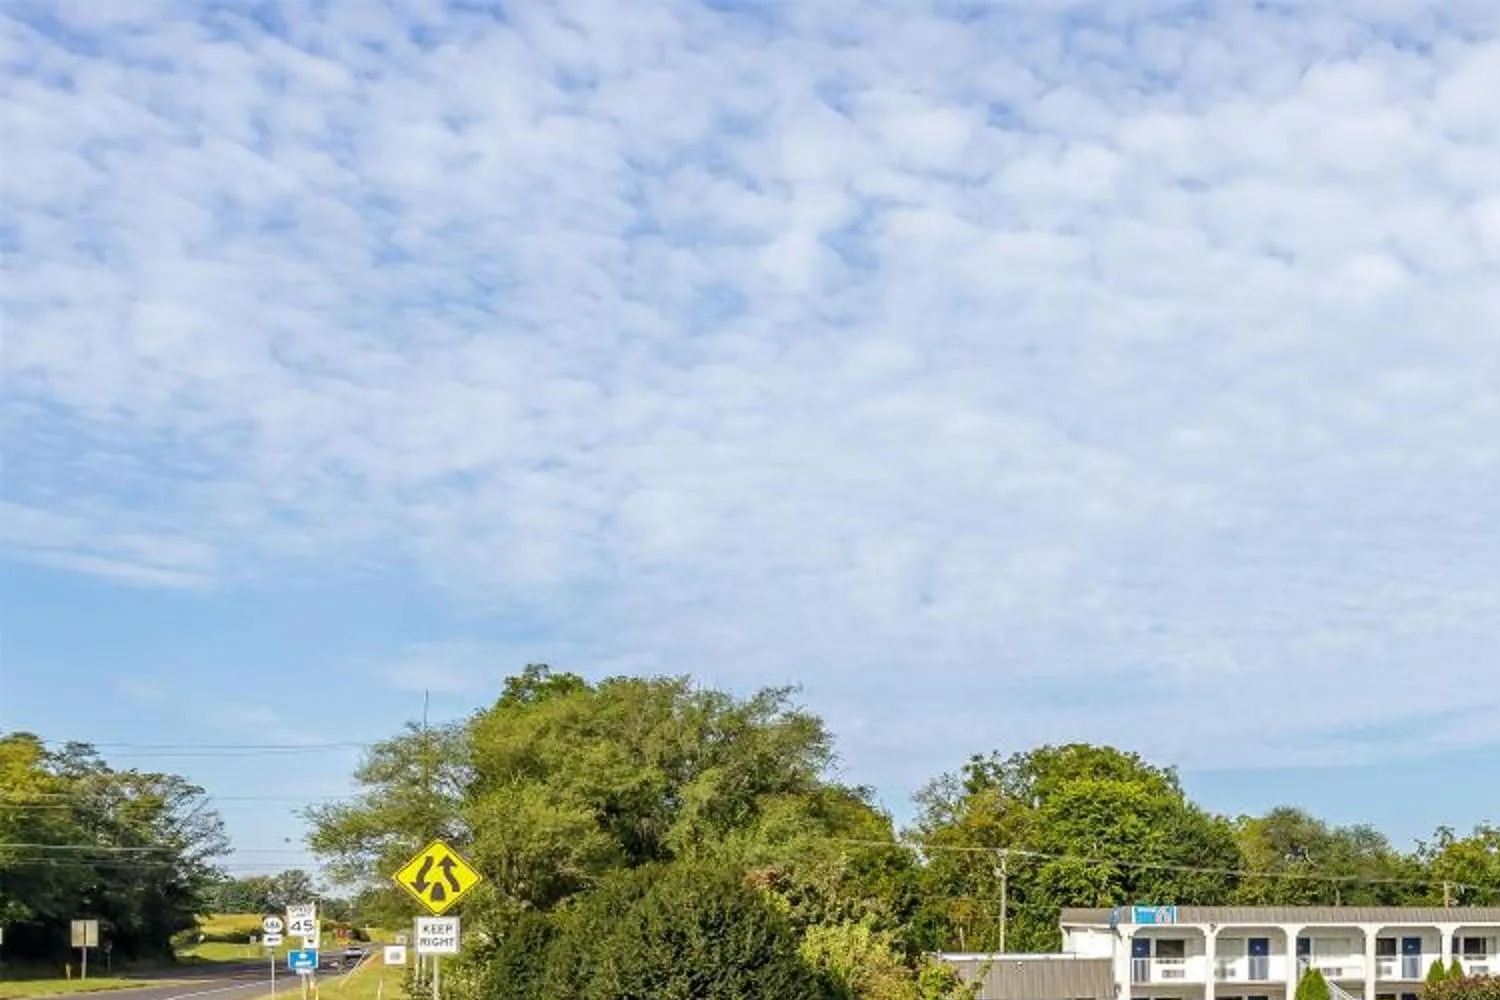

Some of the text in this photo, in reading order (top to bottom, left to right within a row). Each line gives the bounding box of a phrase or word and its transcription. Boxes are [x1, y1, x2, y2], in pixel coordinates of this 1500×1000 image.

[290, 919, 313, 932] 45
[423, 923, 454, 935] KEEP
[420, 937, 455, 947] RIGHT
